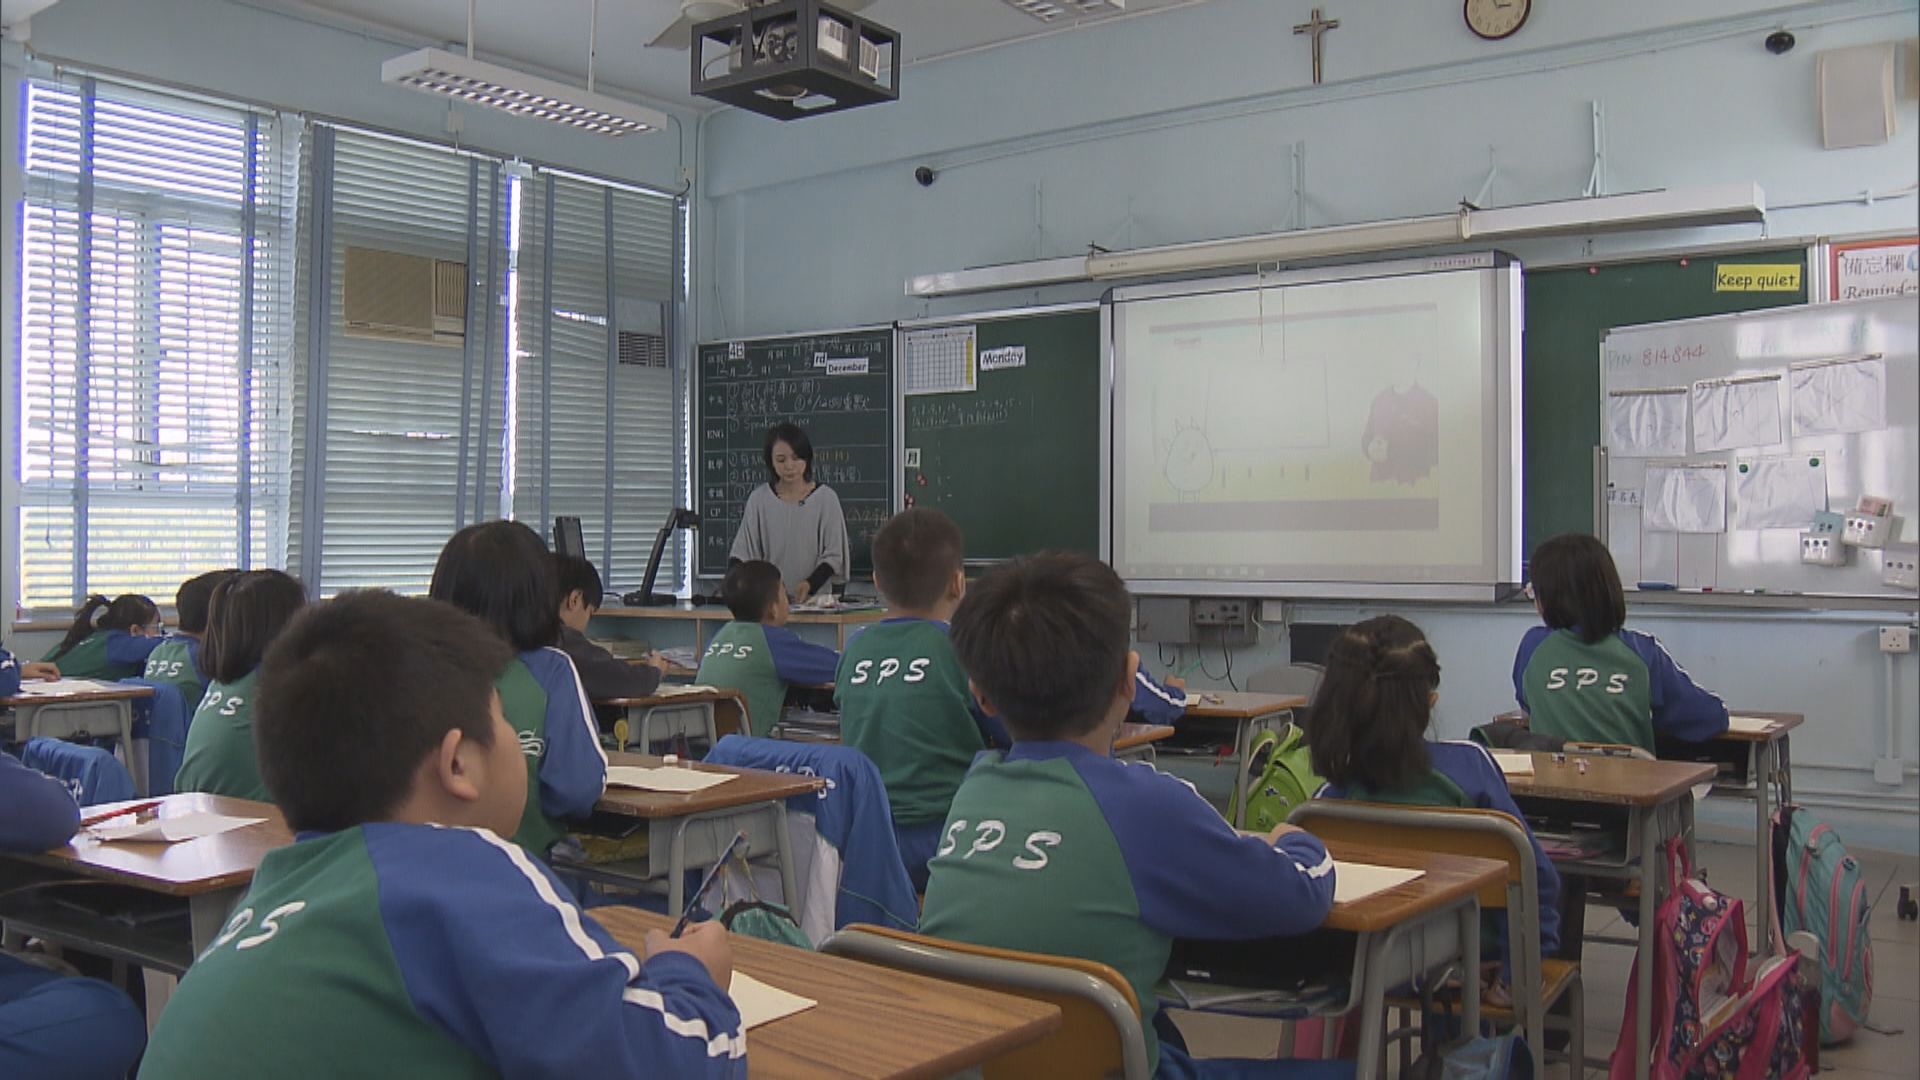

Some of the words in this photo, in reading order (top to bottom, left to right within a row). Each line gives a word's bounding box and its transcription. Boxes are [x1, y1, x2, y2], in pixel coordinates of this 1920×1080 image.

[1844, 255, 1905, 276] 備忘欄
[1718, 273, 1752, 289] Keep
[1757, 273, 1798, 288] quiet.
[982, 350, 1023, 364] Monday
[828, 363, 867, 373] December
[706, 430, 724, 440] ENG
[705, 643, 752, 659] SPS
[146, 660, 184, 677] SPS
[851, 658, 930, 685] SPS
[1547, 668, 1629, 693] SPS
[939, 820, 1062, 869] SPS
